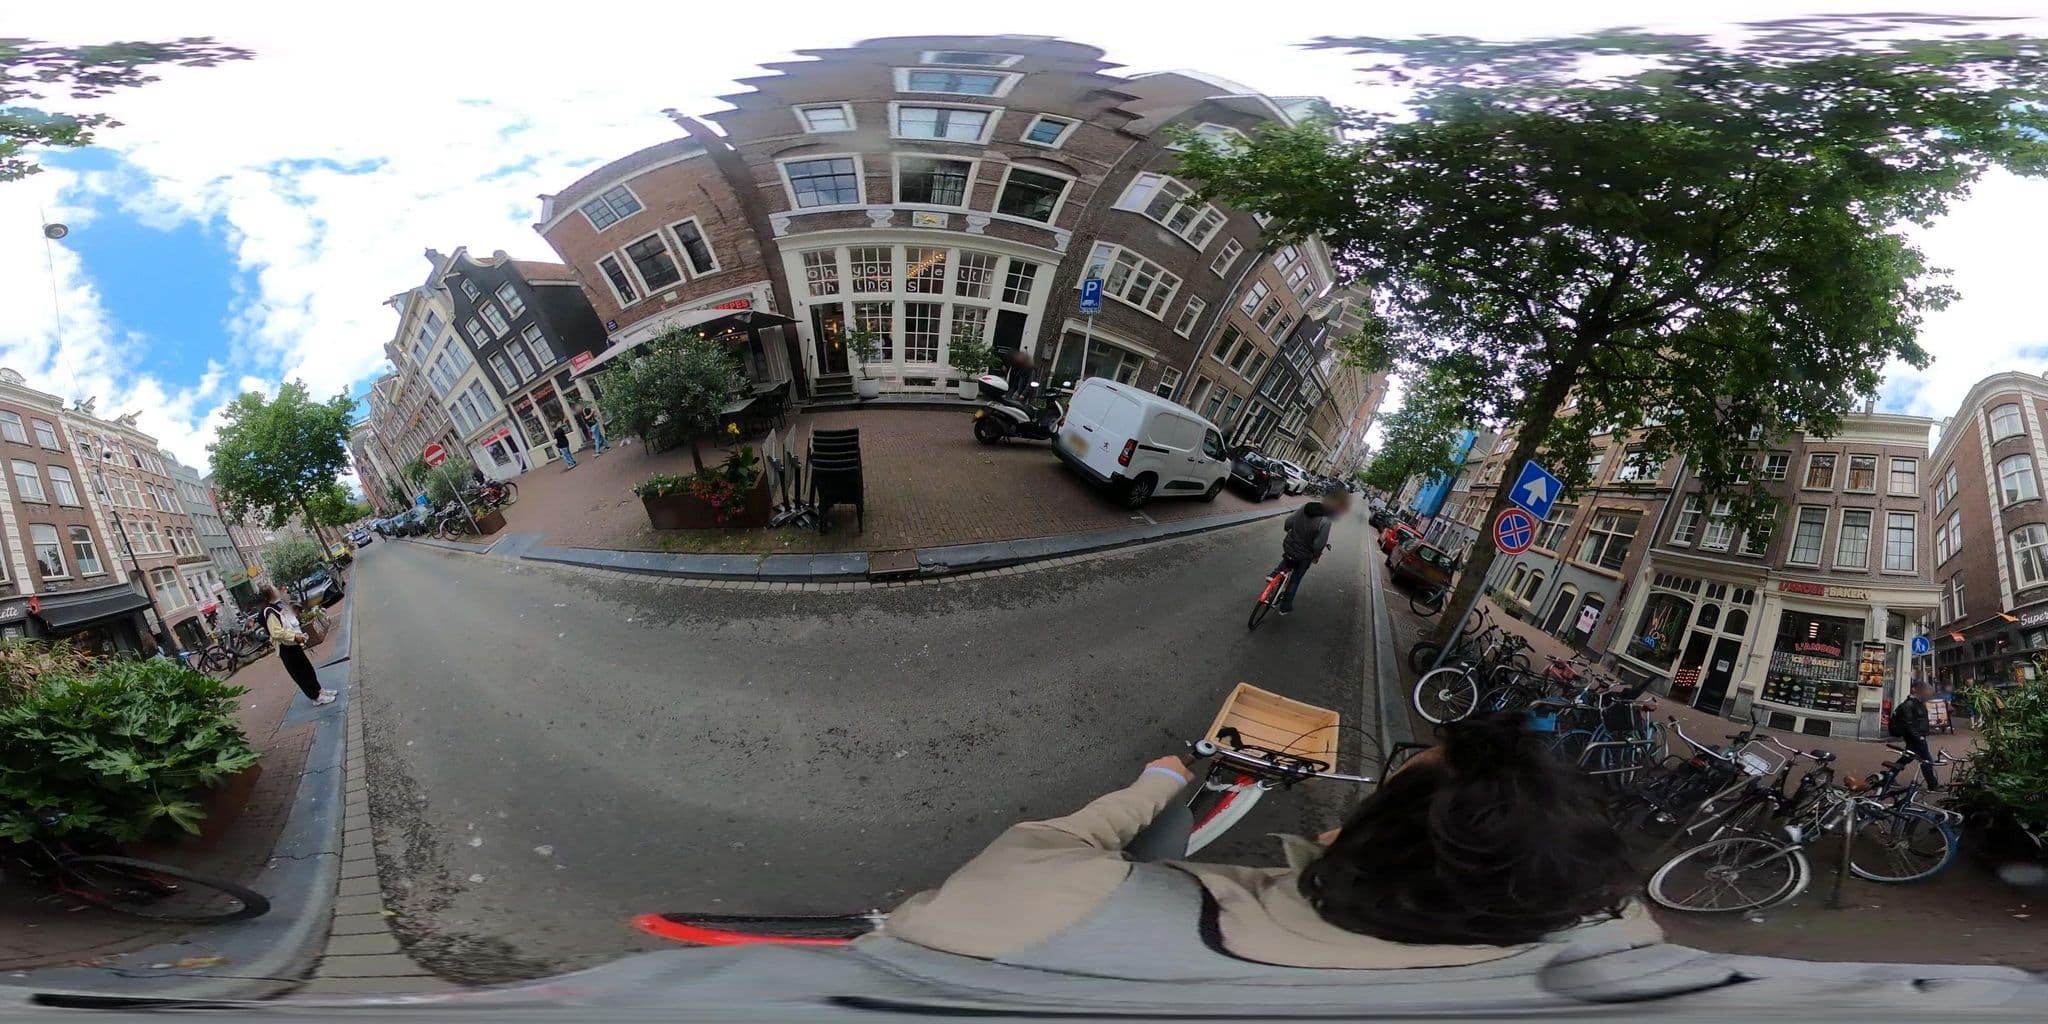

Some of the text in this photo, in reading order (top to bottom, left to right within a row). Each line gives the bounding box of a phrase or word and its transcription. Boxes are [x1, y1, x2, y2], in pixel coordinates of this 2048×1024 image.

[852, 265, 891, 277] you
[1086, 282, 1098, 297] P
[1829, 587, 1872, 600] BAKERY
